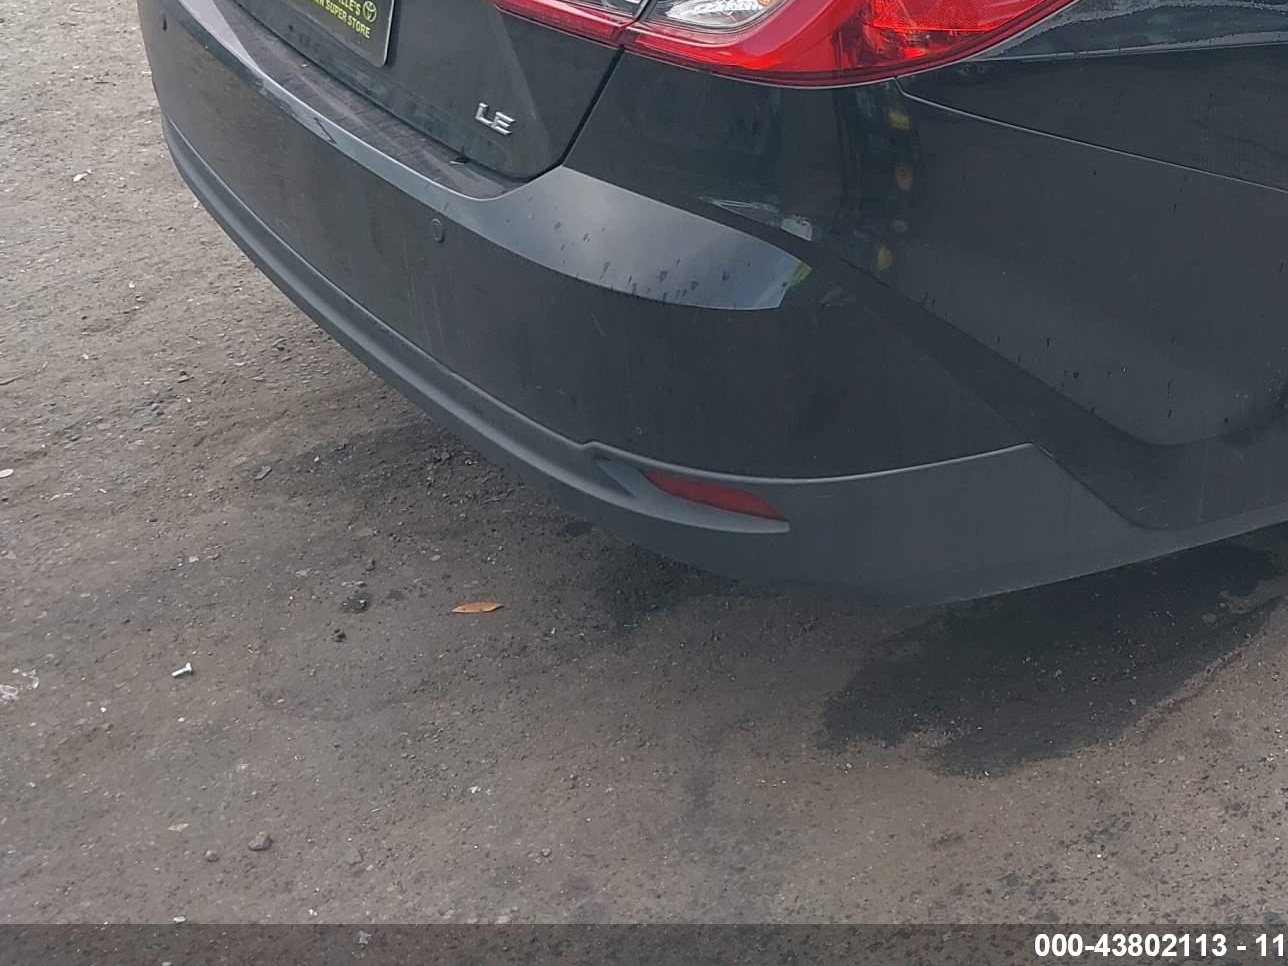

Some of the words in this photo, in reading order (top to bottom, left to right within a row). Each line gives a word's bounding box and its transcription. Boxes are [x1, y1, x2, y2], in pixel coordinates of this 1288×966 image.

[325, 0, 348, 25] SUPER
[347, 14, 372, 40] STORE
[475, 102, 516, 136] LE
